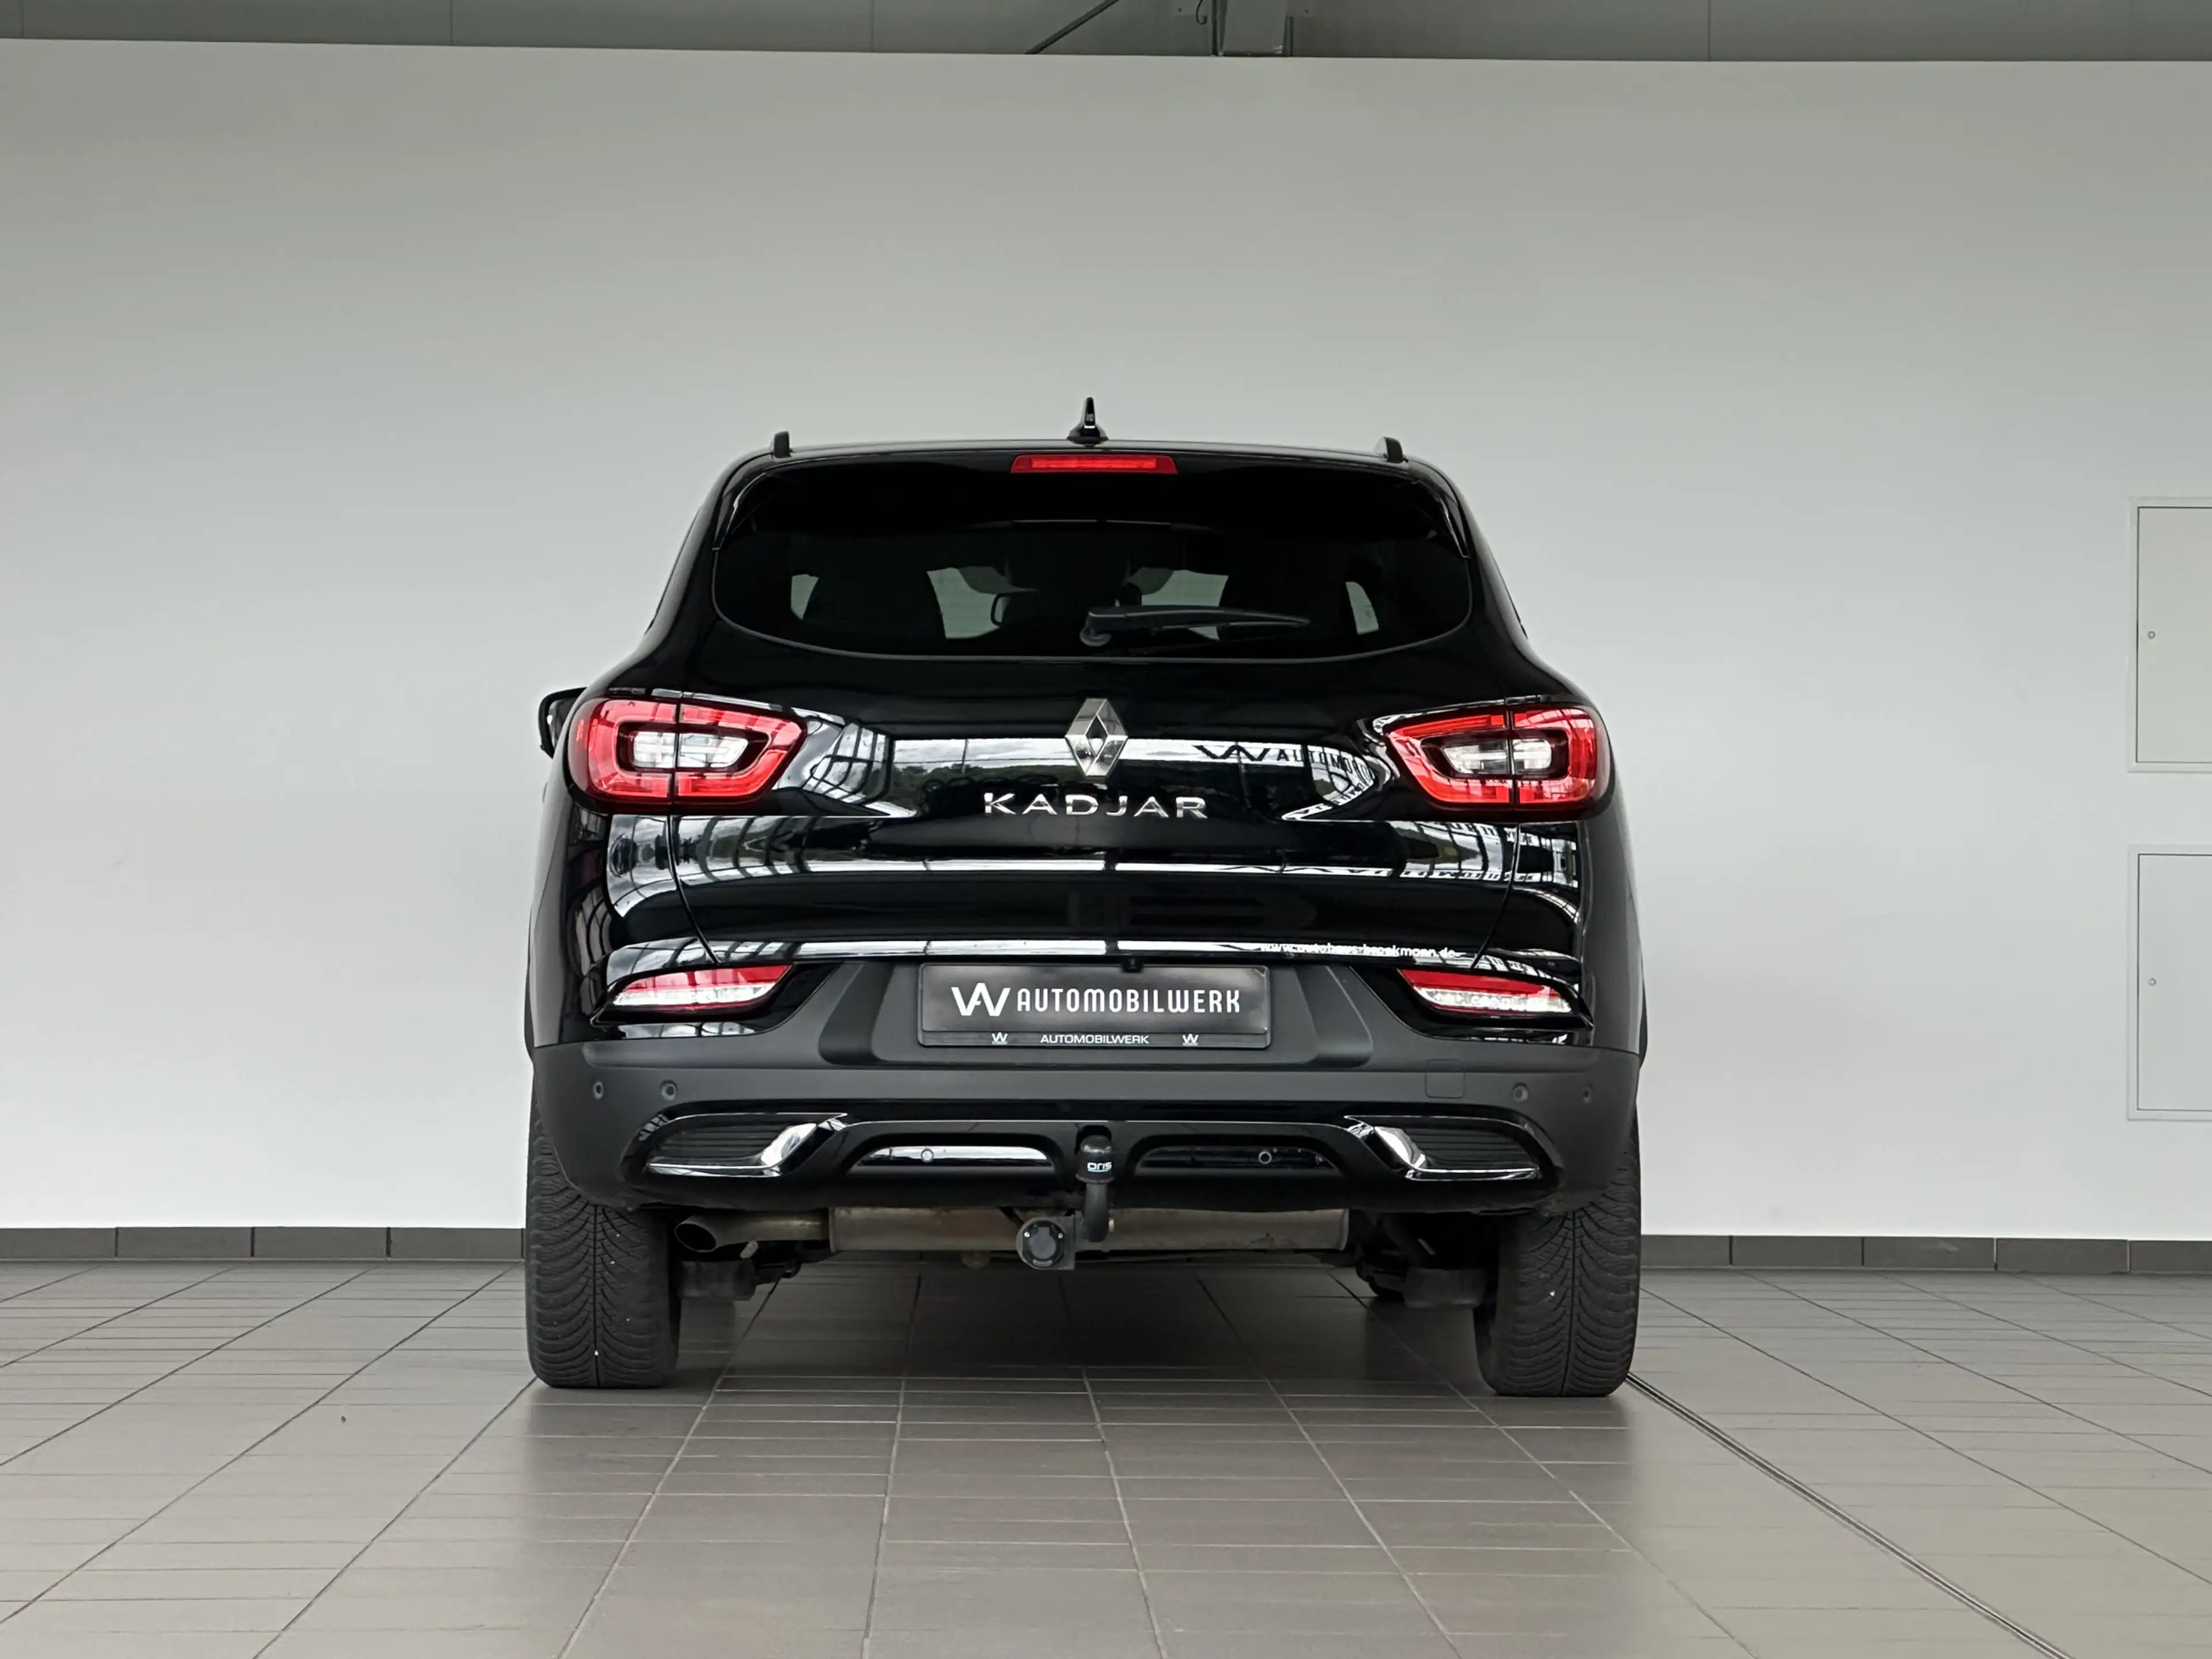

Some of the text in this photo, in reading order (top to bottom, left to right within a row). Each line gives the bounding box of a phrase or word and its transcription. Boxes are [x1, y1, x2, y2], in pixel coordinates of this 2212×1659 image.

[983, 791, 1208, 819] KADJAR
[1017, 988, 1240, 1013] AUTOMOBILWERK
[1040, 1034, 1150, 1045] AUTOMOBILWERK
